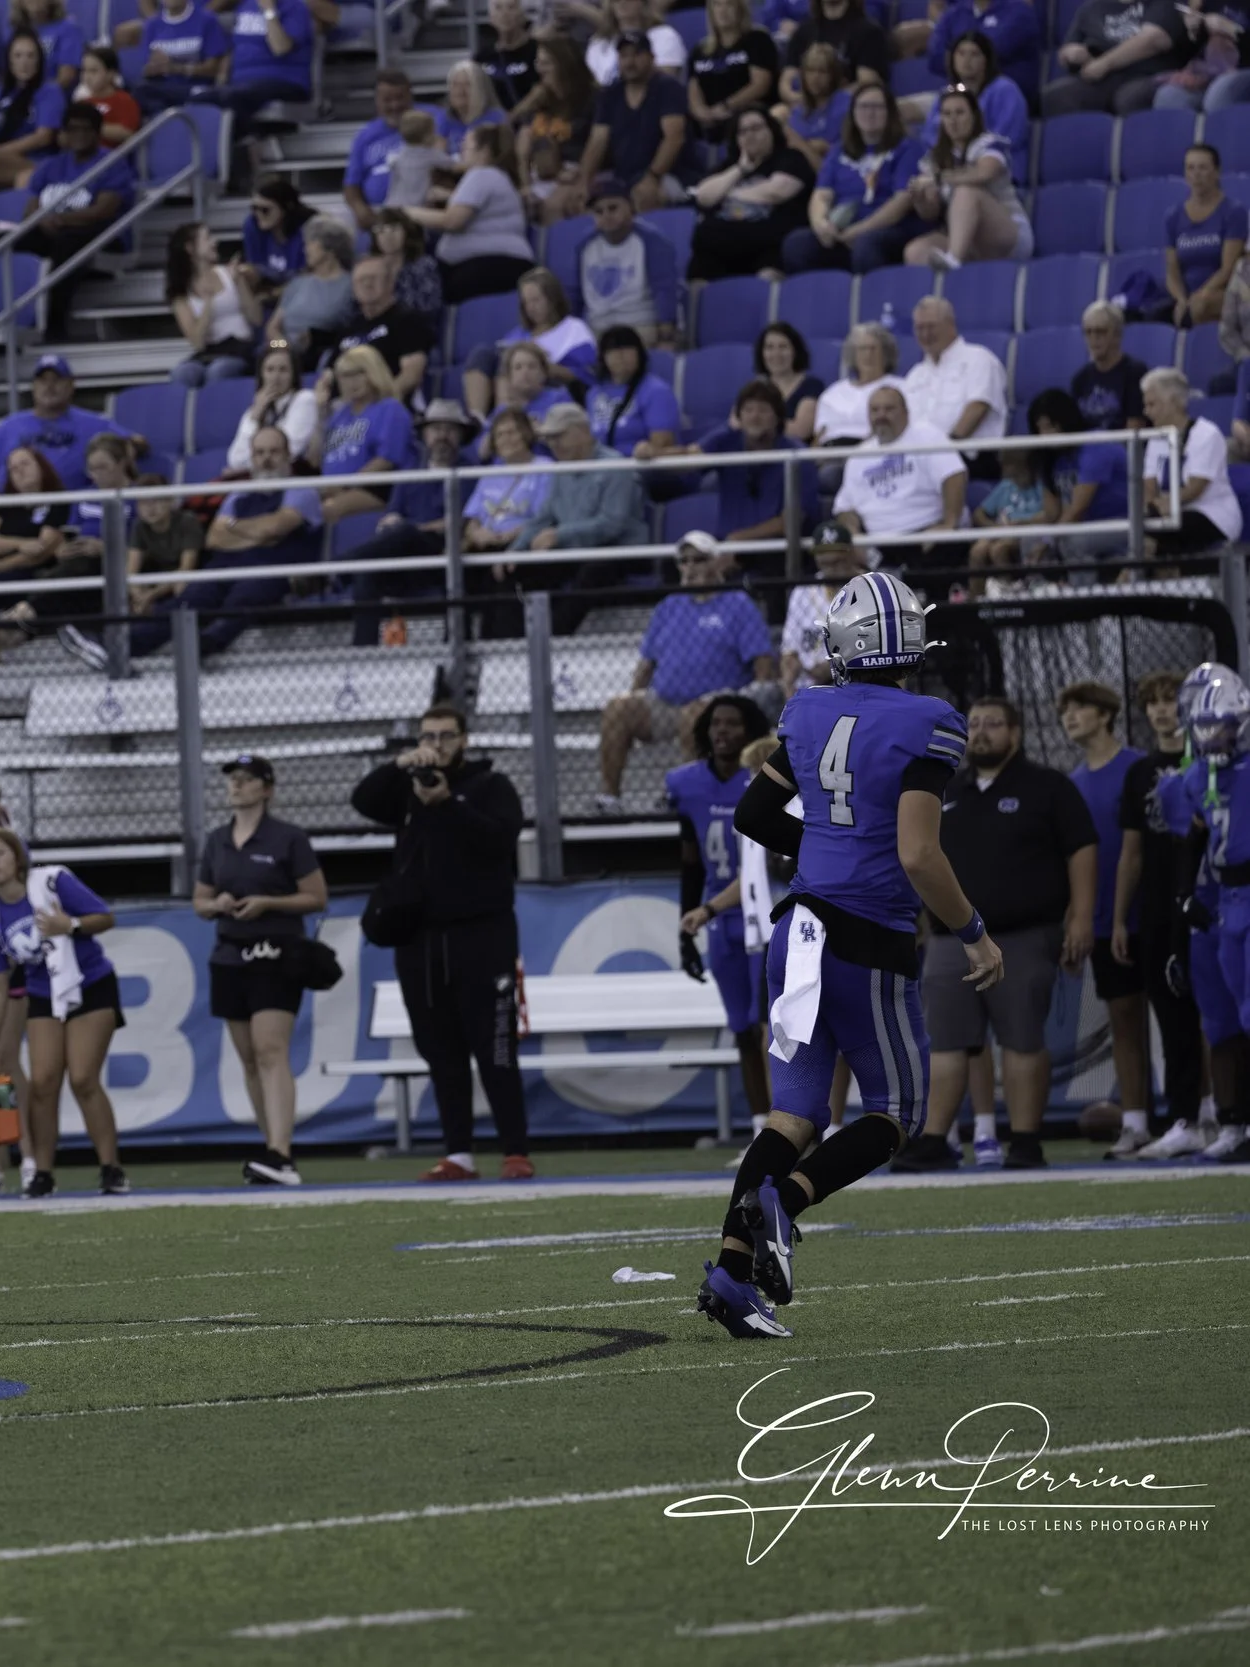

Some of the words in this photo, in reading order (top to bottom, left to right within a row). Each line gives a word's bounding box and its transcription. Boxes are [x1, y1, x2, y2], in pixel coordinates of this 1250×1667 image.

[861, 657, 893, 667] HARD
[895, 653, 920, 664] WAY
[818, 714, 859, 827] 4
